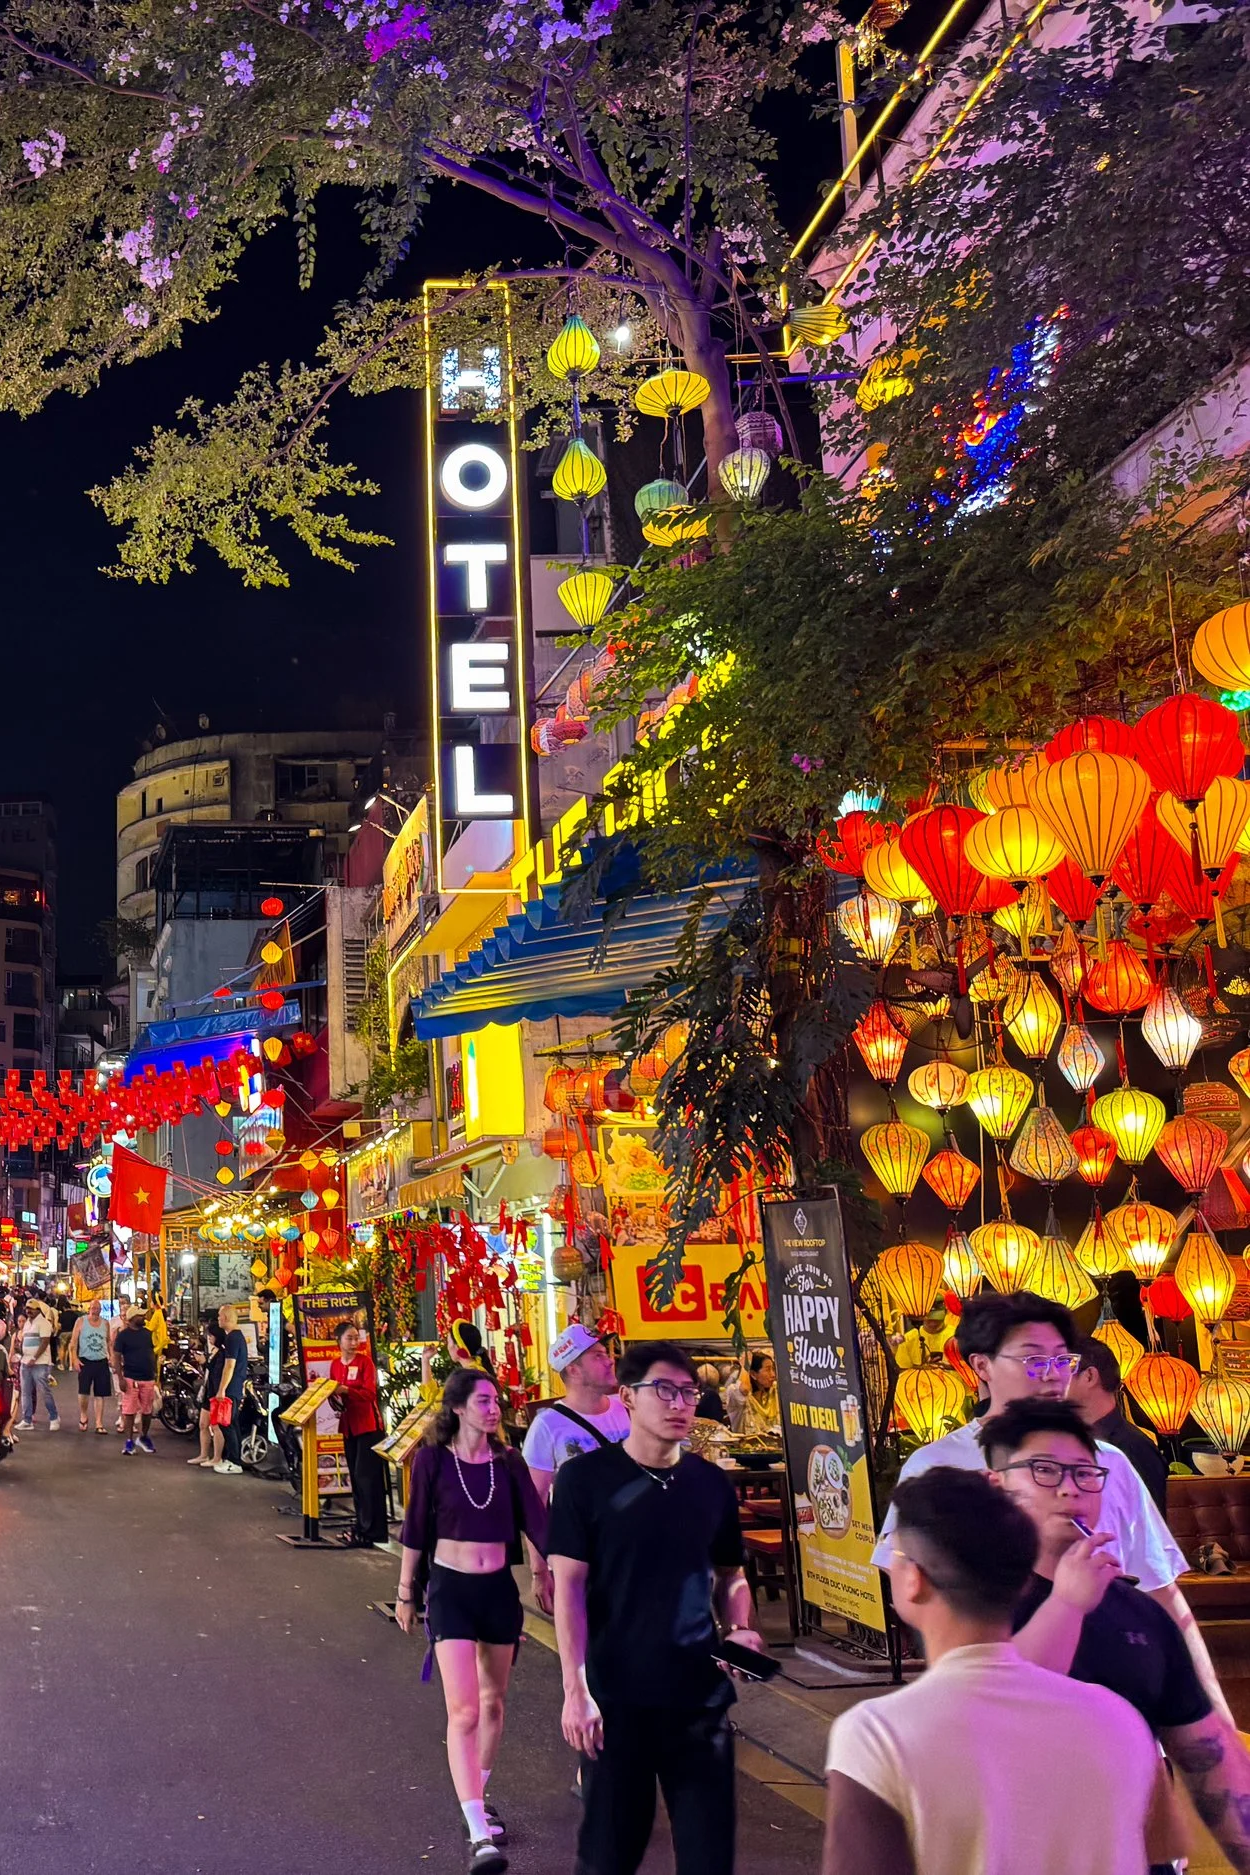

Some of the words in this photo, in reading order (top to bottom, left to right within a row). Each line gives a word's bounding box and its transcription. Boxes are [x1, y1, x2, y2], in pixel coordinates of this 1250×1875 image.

[441, 347, 513, 815] HOTEL
[784, 1263, 804, 1286] PLEASE
[805, 1263, 821, 1277] JOIN
[304, 1299, 328, 1308] THE
[331, 1296, 358, 1307] RICE
[782, 1294, 840, 1339] HAPPY
[793, 1336, 838, 1372] Hour
[800, 1371, 834, 1389] COCKTAILS
[790, 1401, 809, 1427] HOT
[809, 1406, 840, 1433] DEAL
